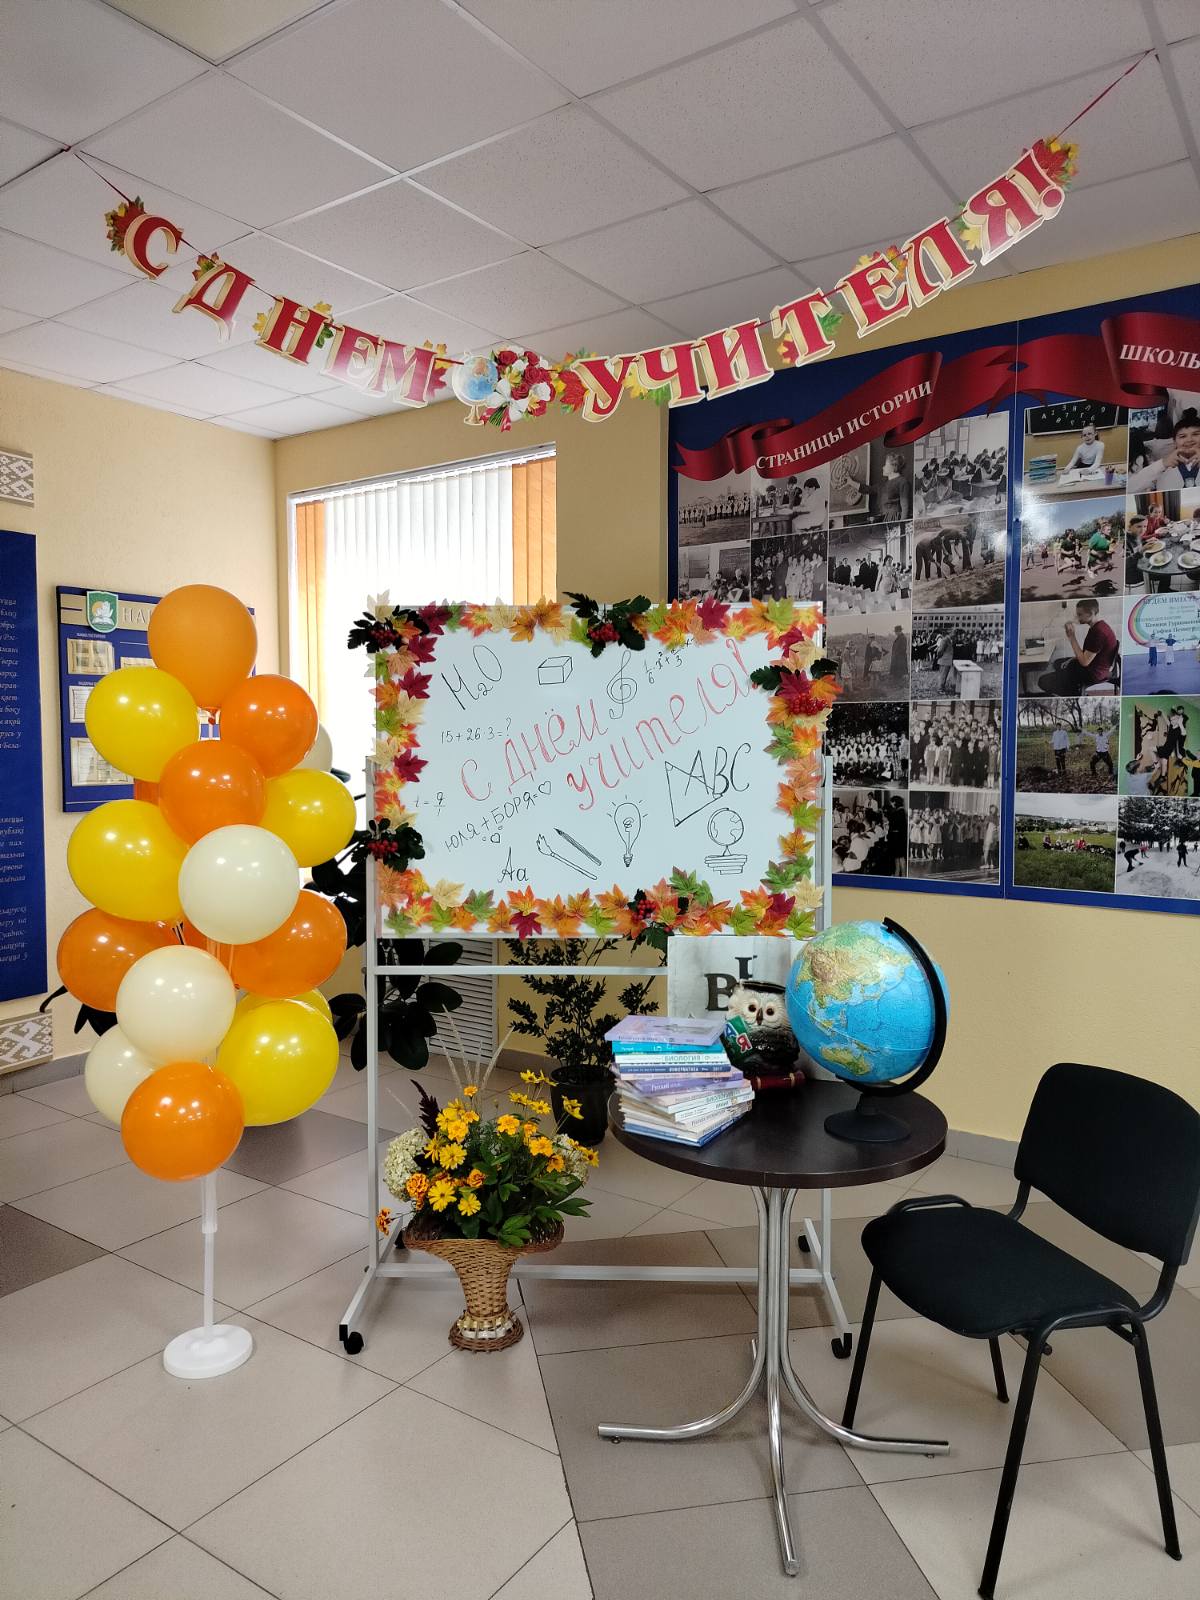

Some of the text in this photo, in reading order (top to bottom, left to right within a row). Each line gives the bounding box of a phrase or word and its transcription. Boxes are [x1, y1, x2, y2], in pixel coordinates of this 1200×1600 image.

[124, 213, 182, 280] С
[573, 149, 1065, 422] УЧИТЕЛЯ!
[756, 427, 844, 469] СТРАНИЦЫ
[847, 381, 933, 434] ИСТОРИИ
